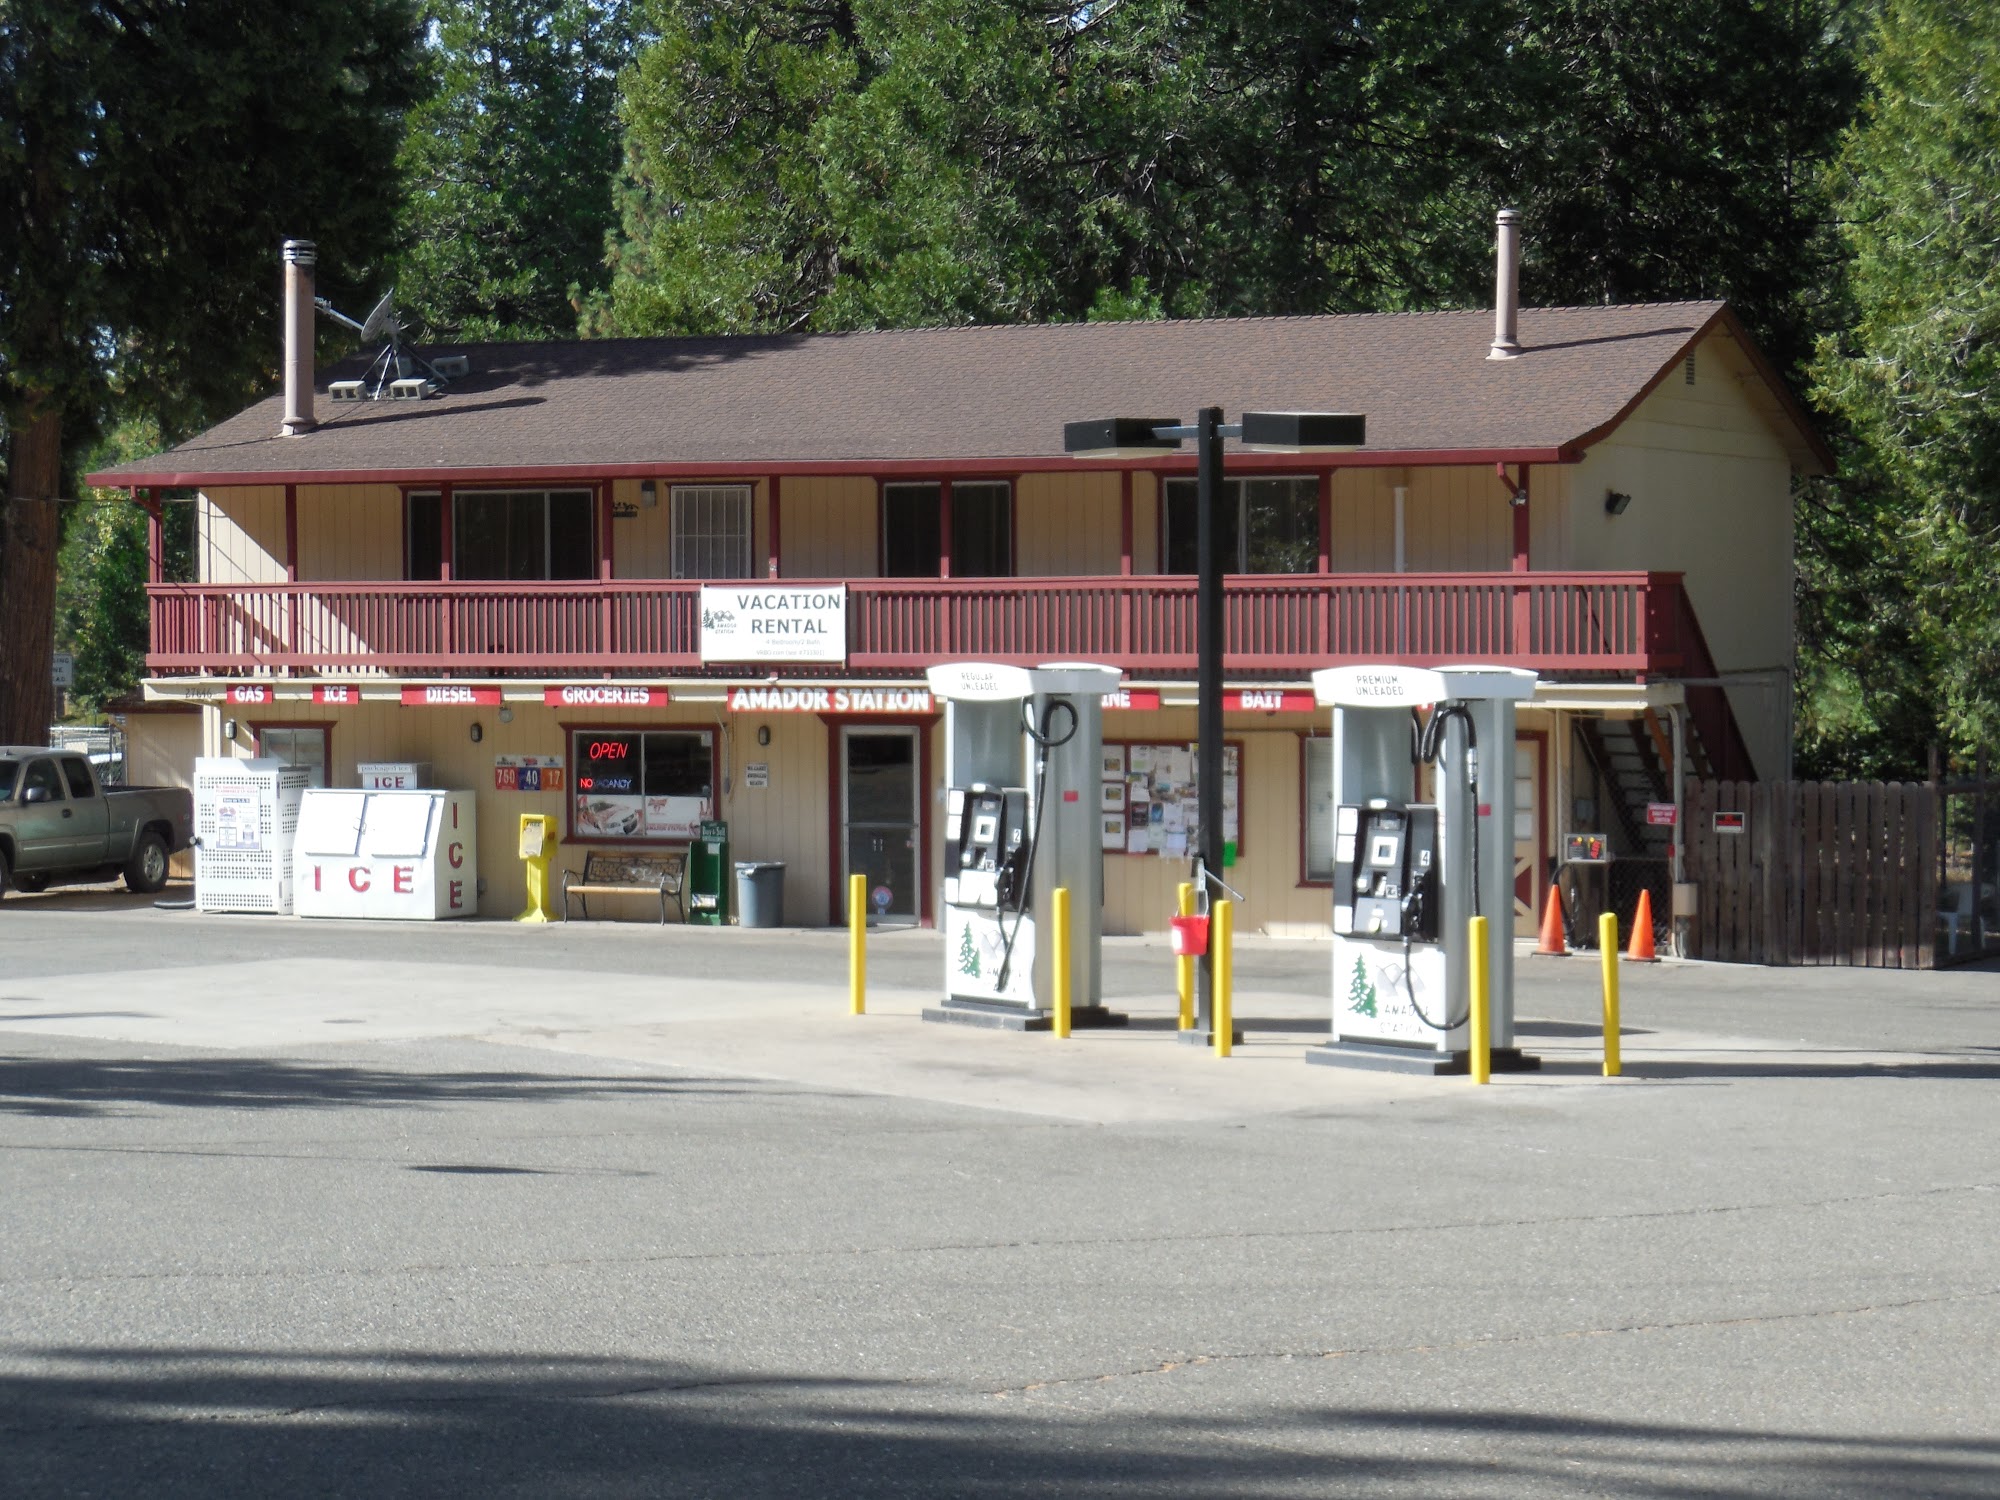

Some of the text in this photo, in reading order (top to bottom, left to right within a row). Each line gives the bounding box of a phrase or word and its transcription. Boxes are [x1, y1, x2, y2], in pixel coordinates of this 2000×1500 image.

[737, 594, 841, 610] VACATION
[751, 619, 828, 634] RENTAL
[960, 672, 994, 681] REGULAR
[1356, 675, 1399, 685] PREMIUM
[234, 685, 265, 703] GAS
[323, 685, 348, 703] ICE
[960, 682, 999, 691] UNLEADED
[1355, 686, 1404, 696] UNLEADED
[426, 686, 477, 703] DIESEL
[562, 686, 650, 704] GROCERIES
[731, 687, 929, 711] AMADOR STATION
[1101, 690, 1131, 708] INE
[1241, 690, 1284, 709] BAIT
[590, 742, 629, 759] OPEN
[375, 776, 405, 789] ICE
[526, 770, 538, 785] 40
[549, 770, 561, 785] 17
[580, 778, 632, 789] NO VACANCY
[1014, 830, 1020, 842] 2
[448, 802, 464, 909] ICE
[1422, 852, 1429, 865] 4
[314, 864, 415, 894] ICE
